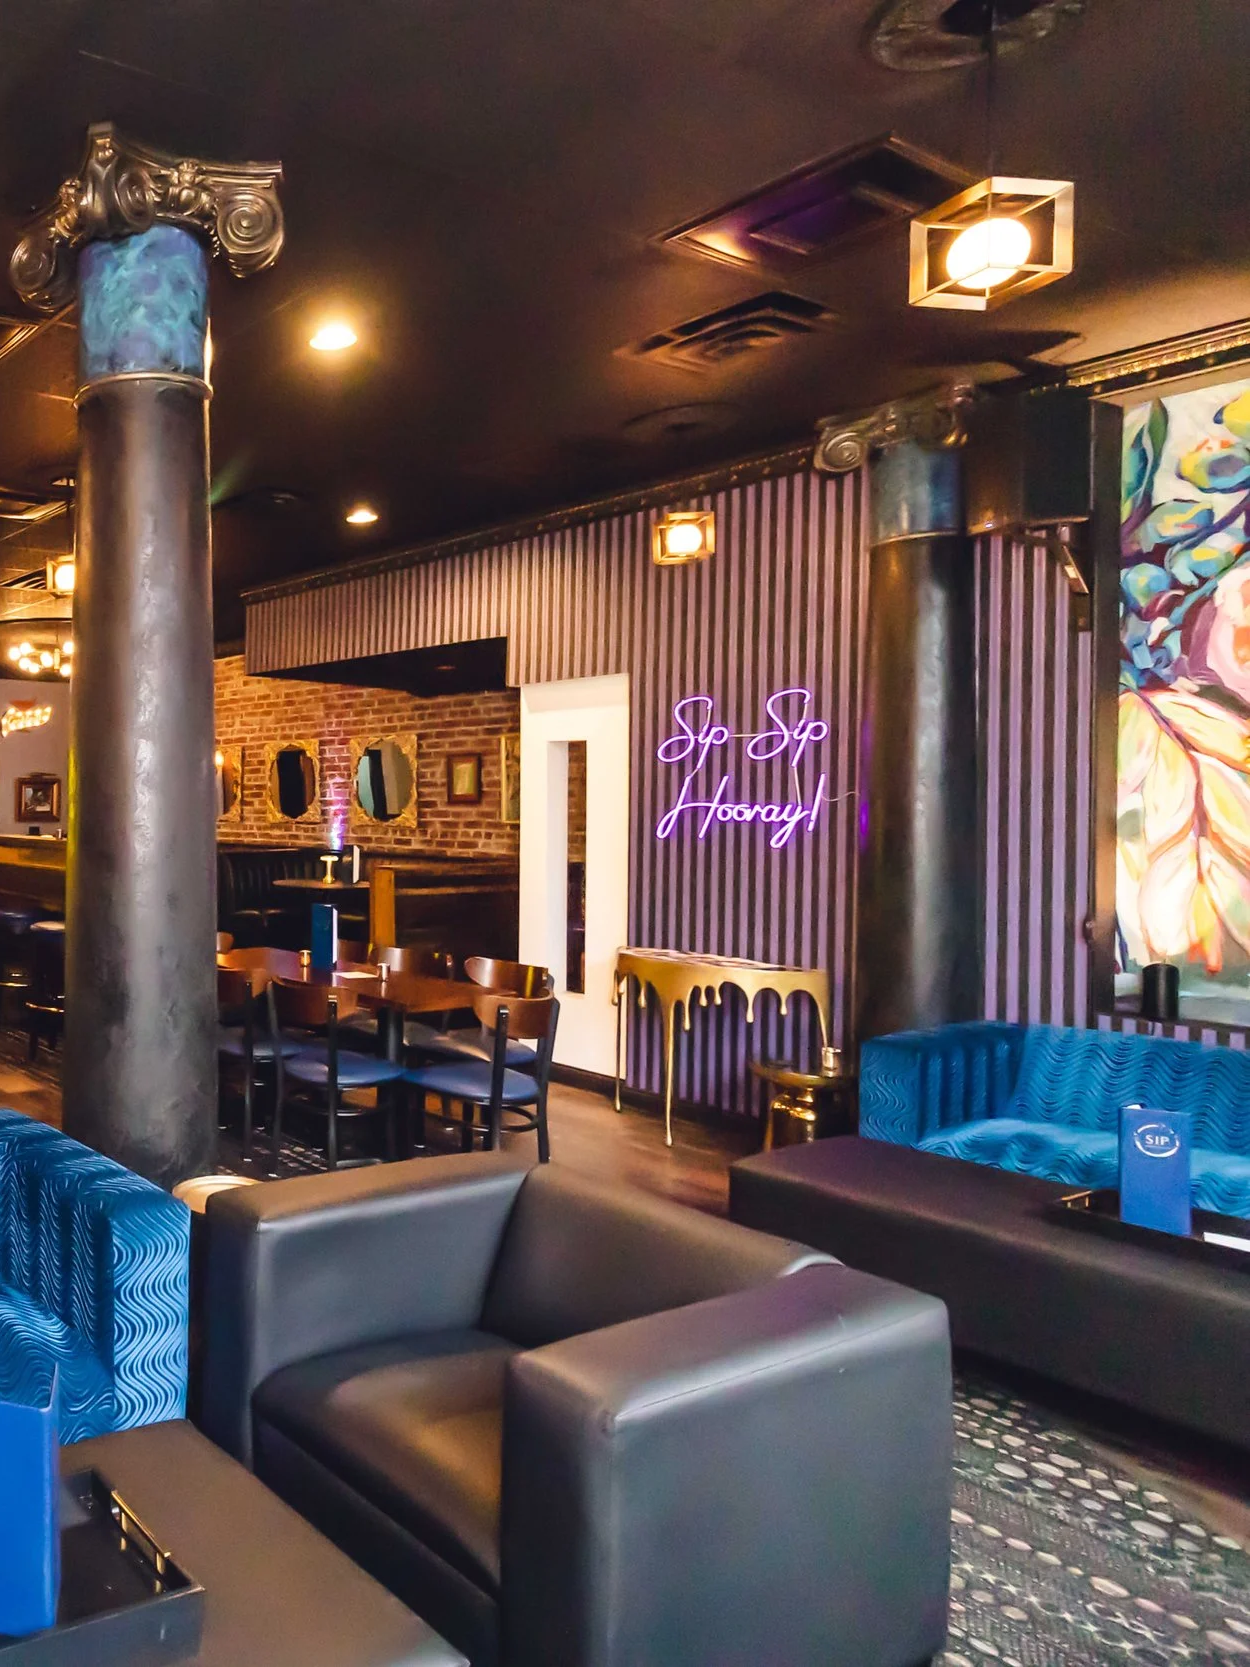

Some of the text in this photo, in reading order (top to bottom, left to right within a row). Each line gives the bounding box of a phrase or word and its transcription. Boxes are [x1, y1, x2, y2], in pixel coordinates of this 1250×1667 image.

[657, 688, 828, 769] Sip Sip
[656, 773, 826, 849] Hooray!
[1145, 1134, 1170, 1146] SIP
